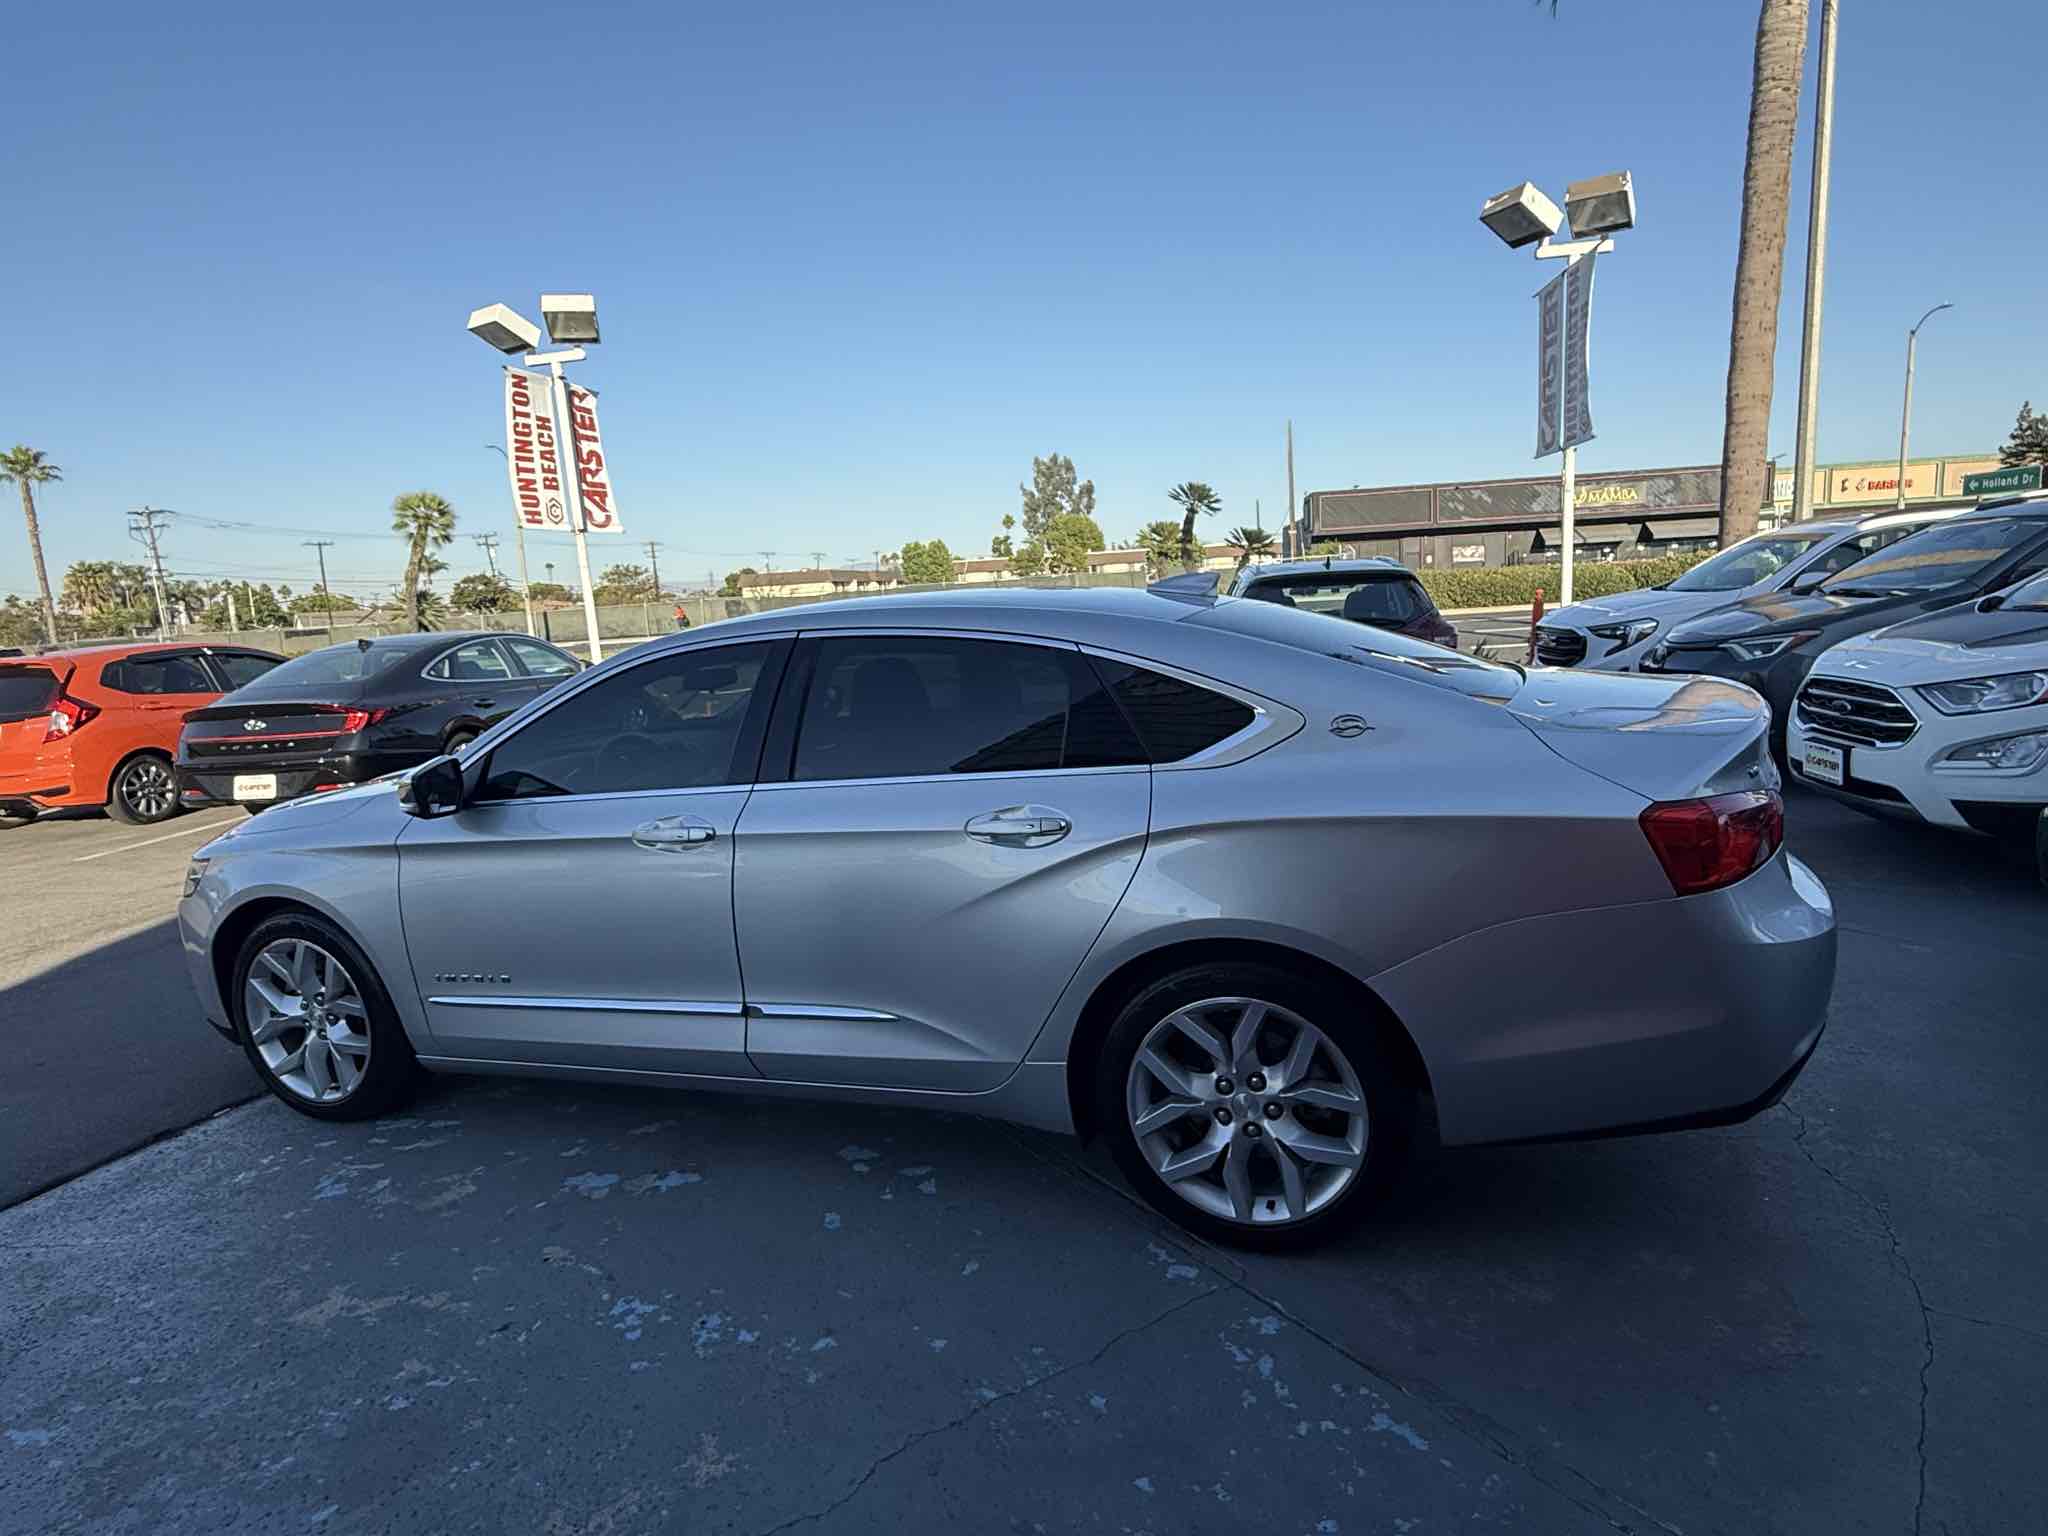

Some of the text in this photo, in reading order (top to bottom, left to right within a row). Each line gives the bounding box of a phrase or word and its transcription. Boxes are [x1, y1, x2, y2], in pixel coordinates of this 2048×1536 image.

[511, 373, 543, 525] HUNTINGTON
[536, 415, 560, 491] BEACH
[571, 389, 612, 528] CARSTER
[1983, 473, 2034, 488] Holland Dr
